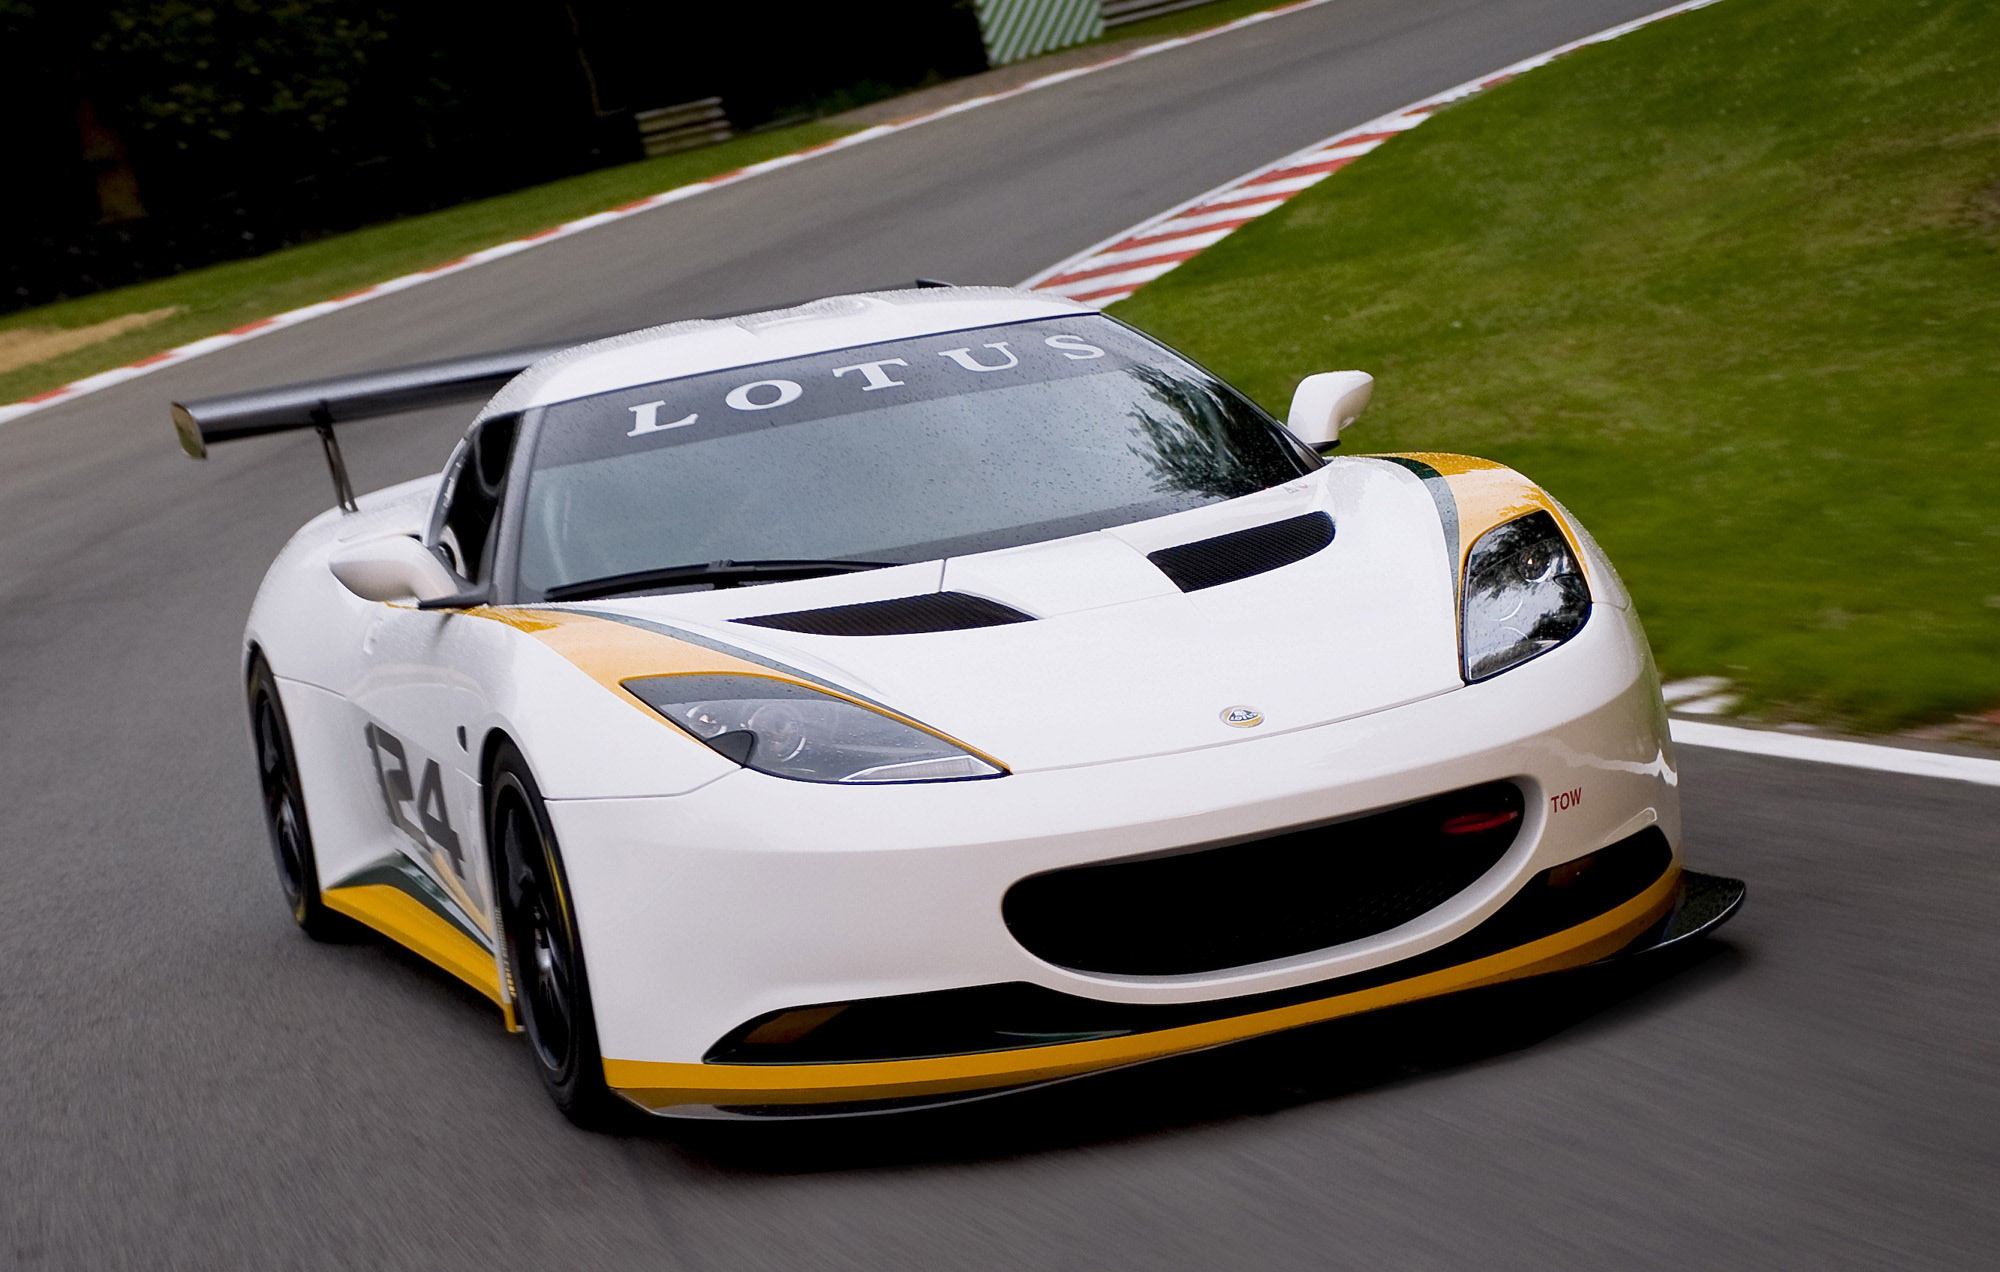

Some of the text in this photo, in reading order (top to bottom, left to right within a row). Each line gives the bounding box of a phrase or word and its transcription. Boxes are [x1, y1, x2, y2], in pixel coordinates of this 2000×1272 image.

[626, 334, 1106, 437] LOTUS
[364, 721, 466, 880] 124
[1550, 787, 1582, 813] TOW
